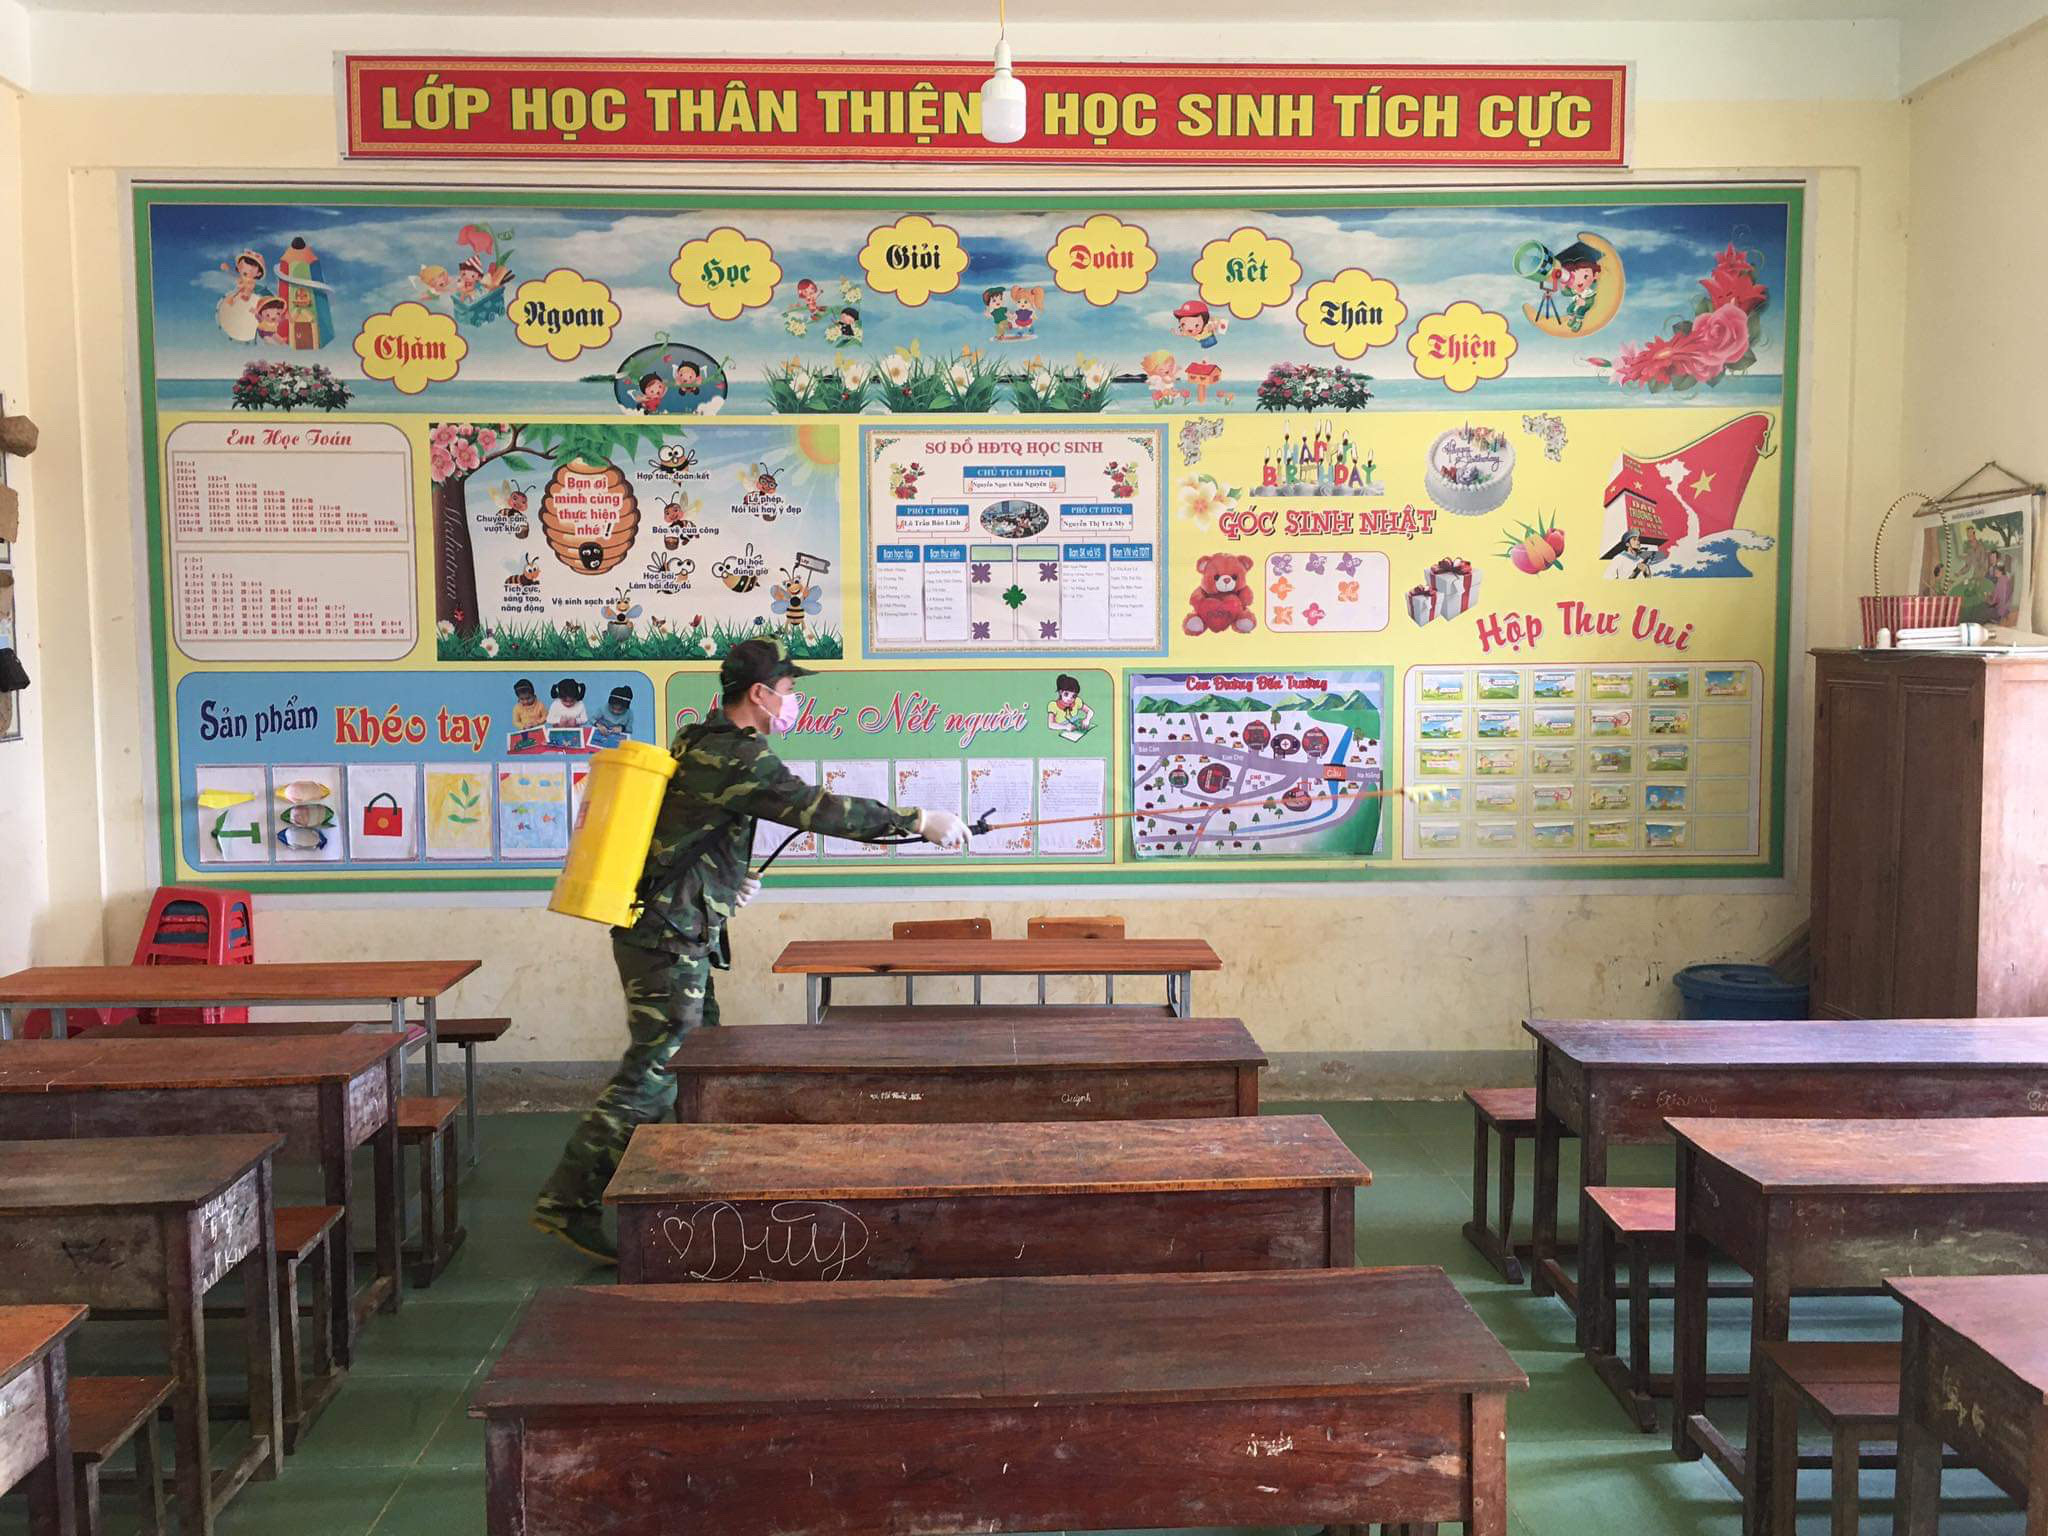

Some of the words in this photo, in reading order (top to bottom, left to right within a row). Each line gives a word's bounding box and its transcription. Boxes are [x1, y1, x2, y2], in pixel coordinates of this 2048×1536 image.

[381, 74, 490, 131] LỚP
[511, 86, 627, 141] HỌC
[645, 80, 798, 134] THÂN
[817, 82, 981, 144] THIỆN
[1043, 91, 1158, 145] HỌC
[1177, 92, 1313, 138] SINH
[1333, 85, 1459, 138] TÍCH
[1478, 90, 1592, 147] CỰC
[886, 242, 941, 273] Giỏi
[1225, 251, 1269, 287] Kết
[701, 259, 751, 294] Học
[523, 300, 605, 333] Ngoan
[1320, 301, 1383, 333] Thân
[374, 334, 447, 367] Chăm
[1428, 334, 1496, 366] Thiện
[227, 429, 255, 446] Em
[263, 429, 300, 450] Học
[306, 429, 352, 446] Toán
[925, 441, 946, 454] SƠ
[951, 437, 974, 454] ĐỒ
[978, 442, 1023, 456] HĐTQ
[1027, 442, 1060, 456] HỌC
[1064, 441, 1103, 454] SINH
[1263, 463, 1376, 488] BIRTHDAY
[591, 509, 616, 522] hiện
[1218, 505, 1277, 540] GÓC
[1285, 509, 1354, 537] SINH
[1359, 505, 1437, 540] NHẬT
[565, 597, 581, 605] sinh
[1476, 612, 1543, 652] Hộp
[1557, 601, 1620, 636] Thư
[1631, 604, 1694, 652] Vui
[1186, 676, 1210, 691] Con
[200, 700, 248, 742] Sản
[255, 695, 319, 742] phẩm
[334, 702, 427, 750] Khéo
[436, 705, 491, 752] tay
[857, 692, 941, 734] Nết
[944, 703, 1030, 748] người
